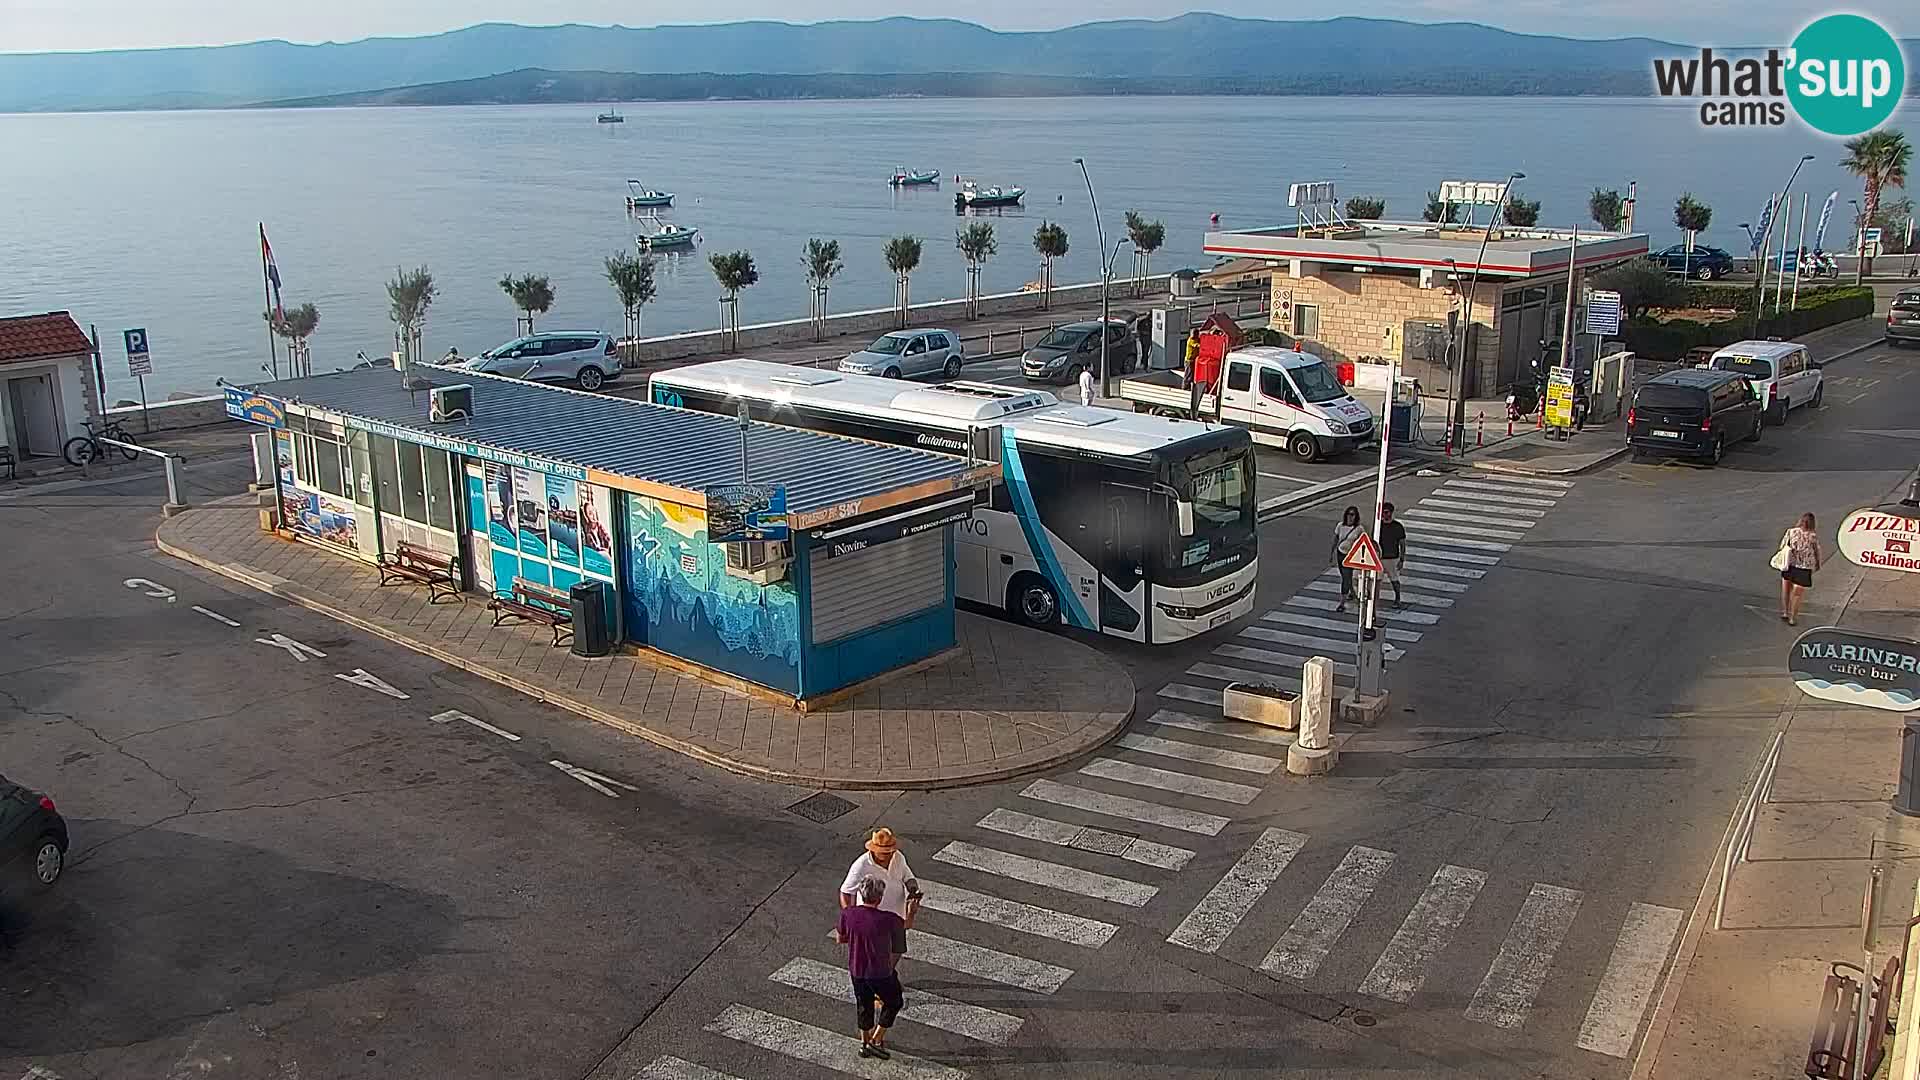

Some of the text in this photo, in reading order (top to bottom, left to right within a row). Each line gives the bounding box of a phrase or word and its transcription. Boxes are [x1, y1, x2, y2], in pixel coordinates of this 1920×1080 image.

[129, 332, 142, 350] P
[436, 438, 469, 453] POSTAJA
[477, 446, 492, 459] BUS
[493, 451, 526, 466] STATION
[528, 459, 555, 473] TICKET
[555, 464, 583, 479] OFFICE
[1848, 516, 1920, 535] PIZZE
[1882, 531, 1918, 542] GRILL
[1206, 582, 1236, 600] IVECO
[1829, 662, 1898, 682] caffe bar
